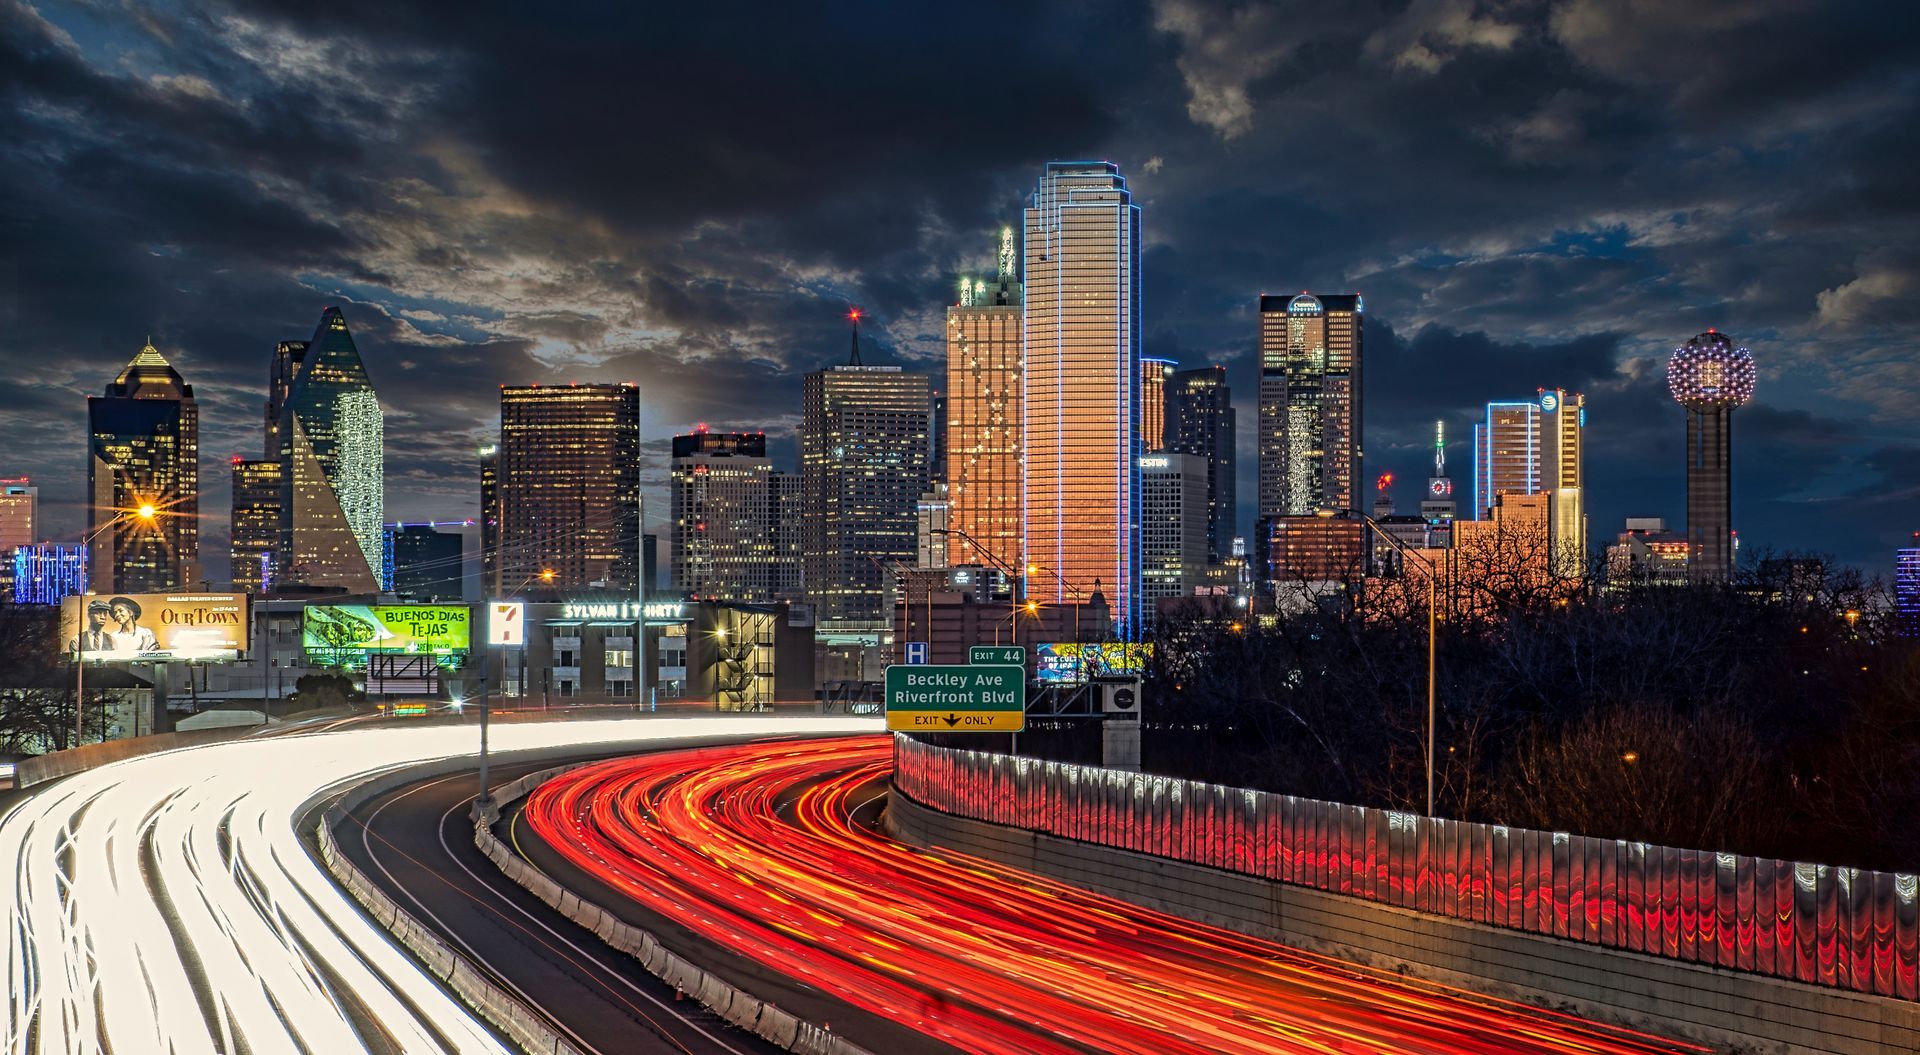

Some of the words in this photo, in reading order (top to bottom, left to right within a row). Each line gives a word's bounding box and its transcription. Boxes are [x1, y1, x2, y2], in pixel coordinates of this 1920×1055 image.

[385, 610, 435, 623] BUENOS
[438, 610, 465, 622] DIAS
[565, 604, 618, 618] SYLVAN
[409, 622, 448, 637] TEJAS
[908, 644, 925, 664] H
[974, 652, 995, 660] EXIT
[1003, 650, 1020, 661] 44
[907, 673, 968, 689] Beckley
[975, 674, 1003, 686] Ave
[895, 690, 974, 703] Riverfront
[982, 691, 1015, 703] Blvd
[915, 716, 939, 725] EXIT
[964, 716, 995, 725] ONLY
